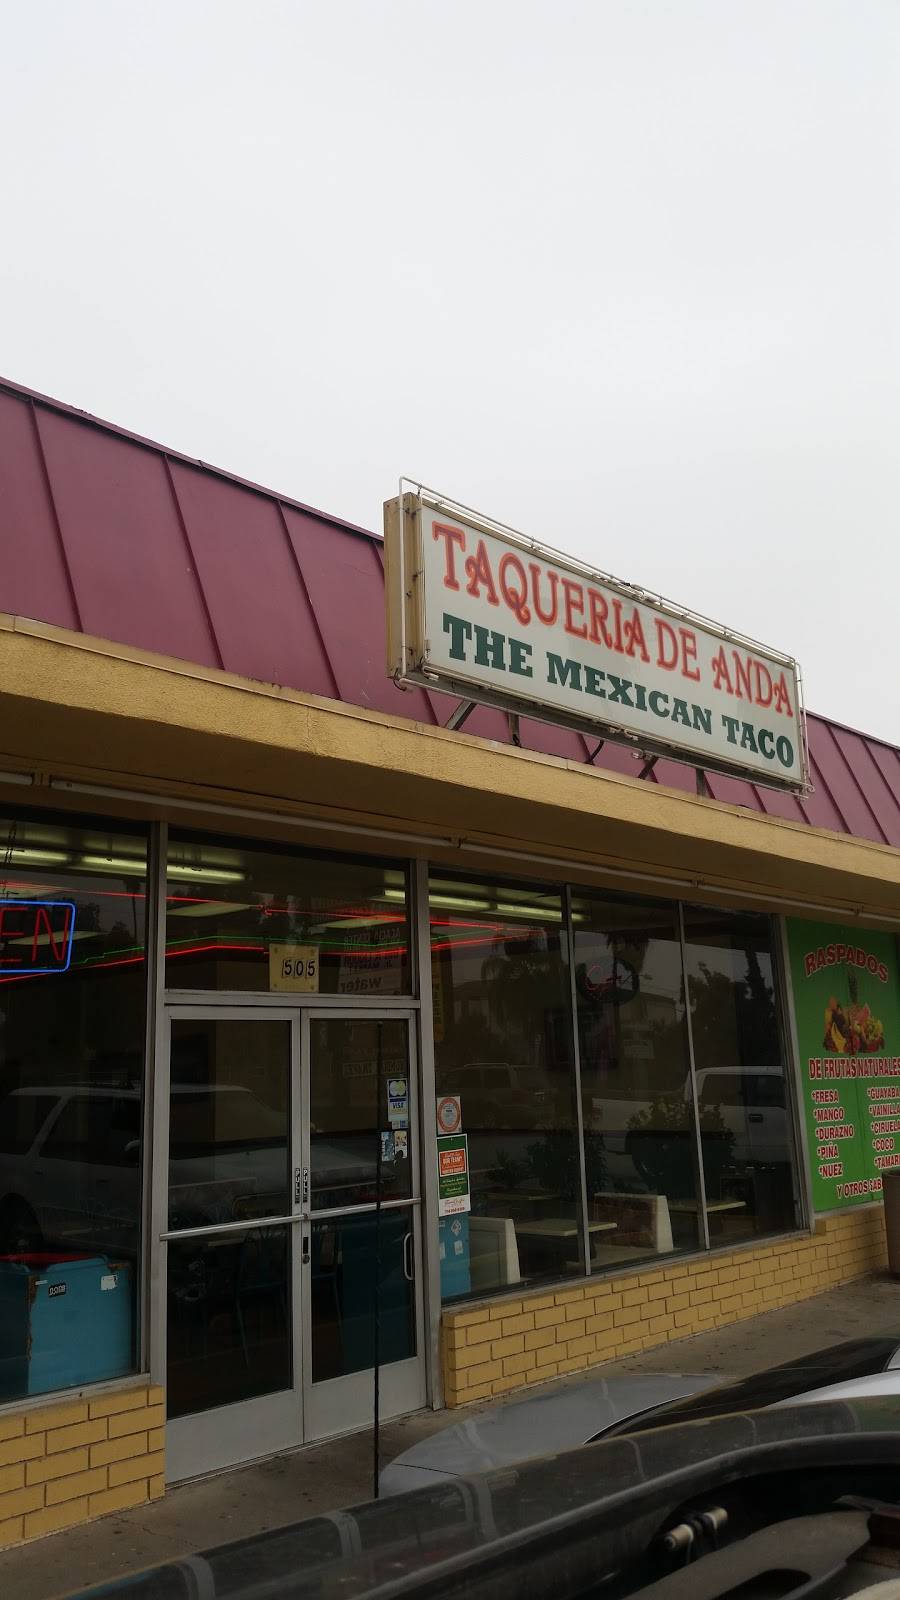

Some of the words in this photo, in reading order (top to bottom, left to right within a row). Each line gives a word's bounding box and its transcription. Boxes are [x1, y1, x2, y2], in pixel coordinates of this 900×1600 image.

[432, 521, 650, 663] TAQUERIA
[655, 616, 701, 682] DE
[711, 644, 794, 718] ANDA
[443, 612, 533, 678] THE
[546, 651, 712, 735] MEXICAN
[721, 714, 794, 768] TACO
[284, 960, 316, 977] 505
[804, 944, 888, 983] RASPADOS
[809, 1059, 821, 1079] DE
[824, 1058, 857, 1078] FRUTAS
[858, 1056, 900, 1077] NATURALES
[815, 1090, 839, 1103] FRESA
[817, 1107, 845, 1122] MANGO
[819, 1124, 854, 1140] DURAZNO
[875, 1138, 894, 1151] COCO
[822, 1162, 843, 1178] NUEZ
[837, 1184, 843, 1199] Y
[844, 1180, 868, 1197] OTROS
[869, 1178, 884, 1192] SAB
